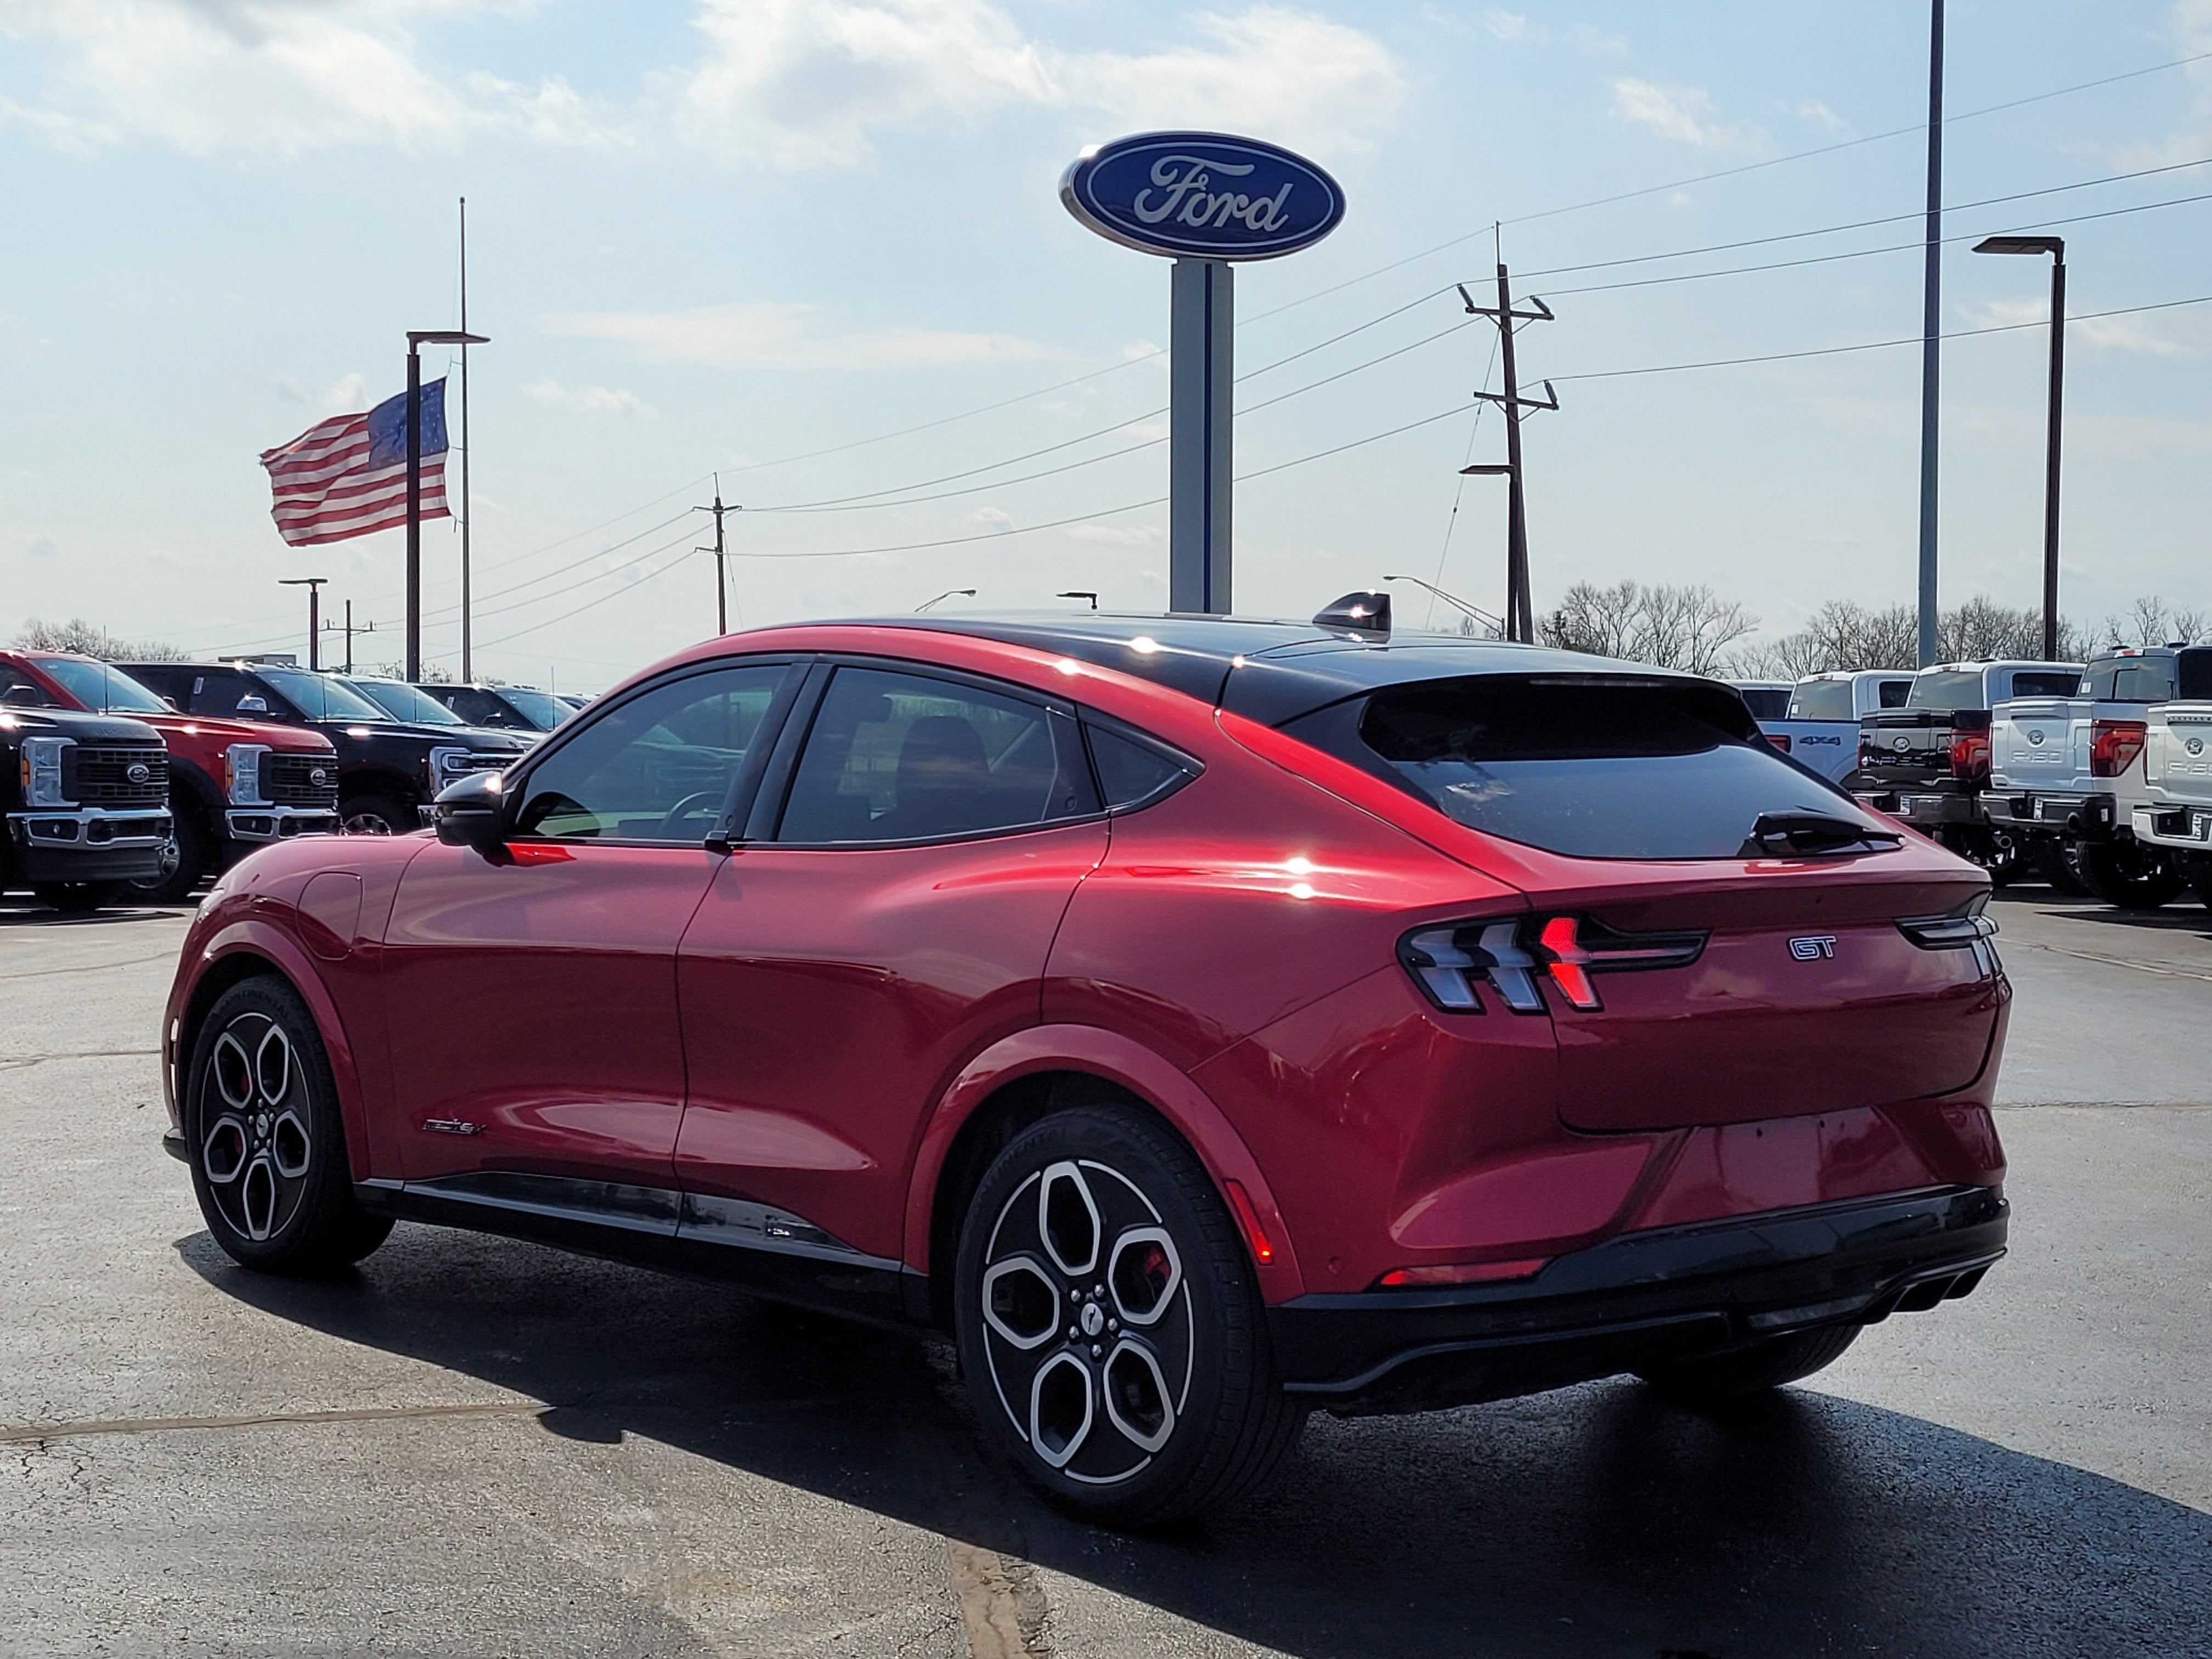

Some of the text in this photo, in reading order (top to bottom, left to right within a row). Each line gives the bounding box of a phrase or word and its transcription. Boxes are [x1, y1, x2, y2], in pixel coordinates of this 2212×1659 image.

[1134, 155, 1293, 232] Ford
[2011, 749, 2062, 764] F-150
[1787, 935, 1837, 961] GT
